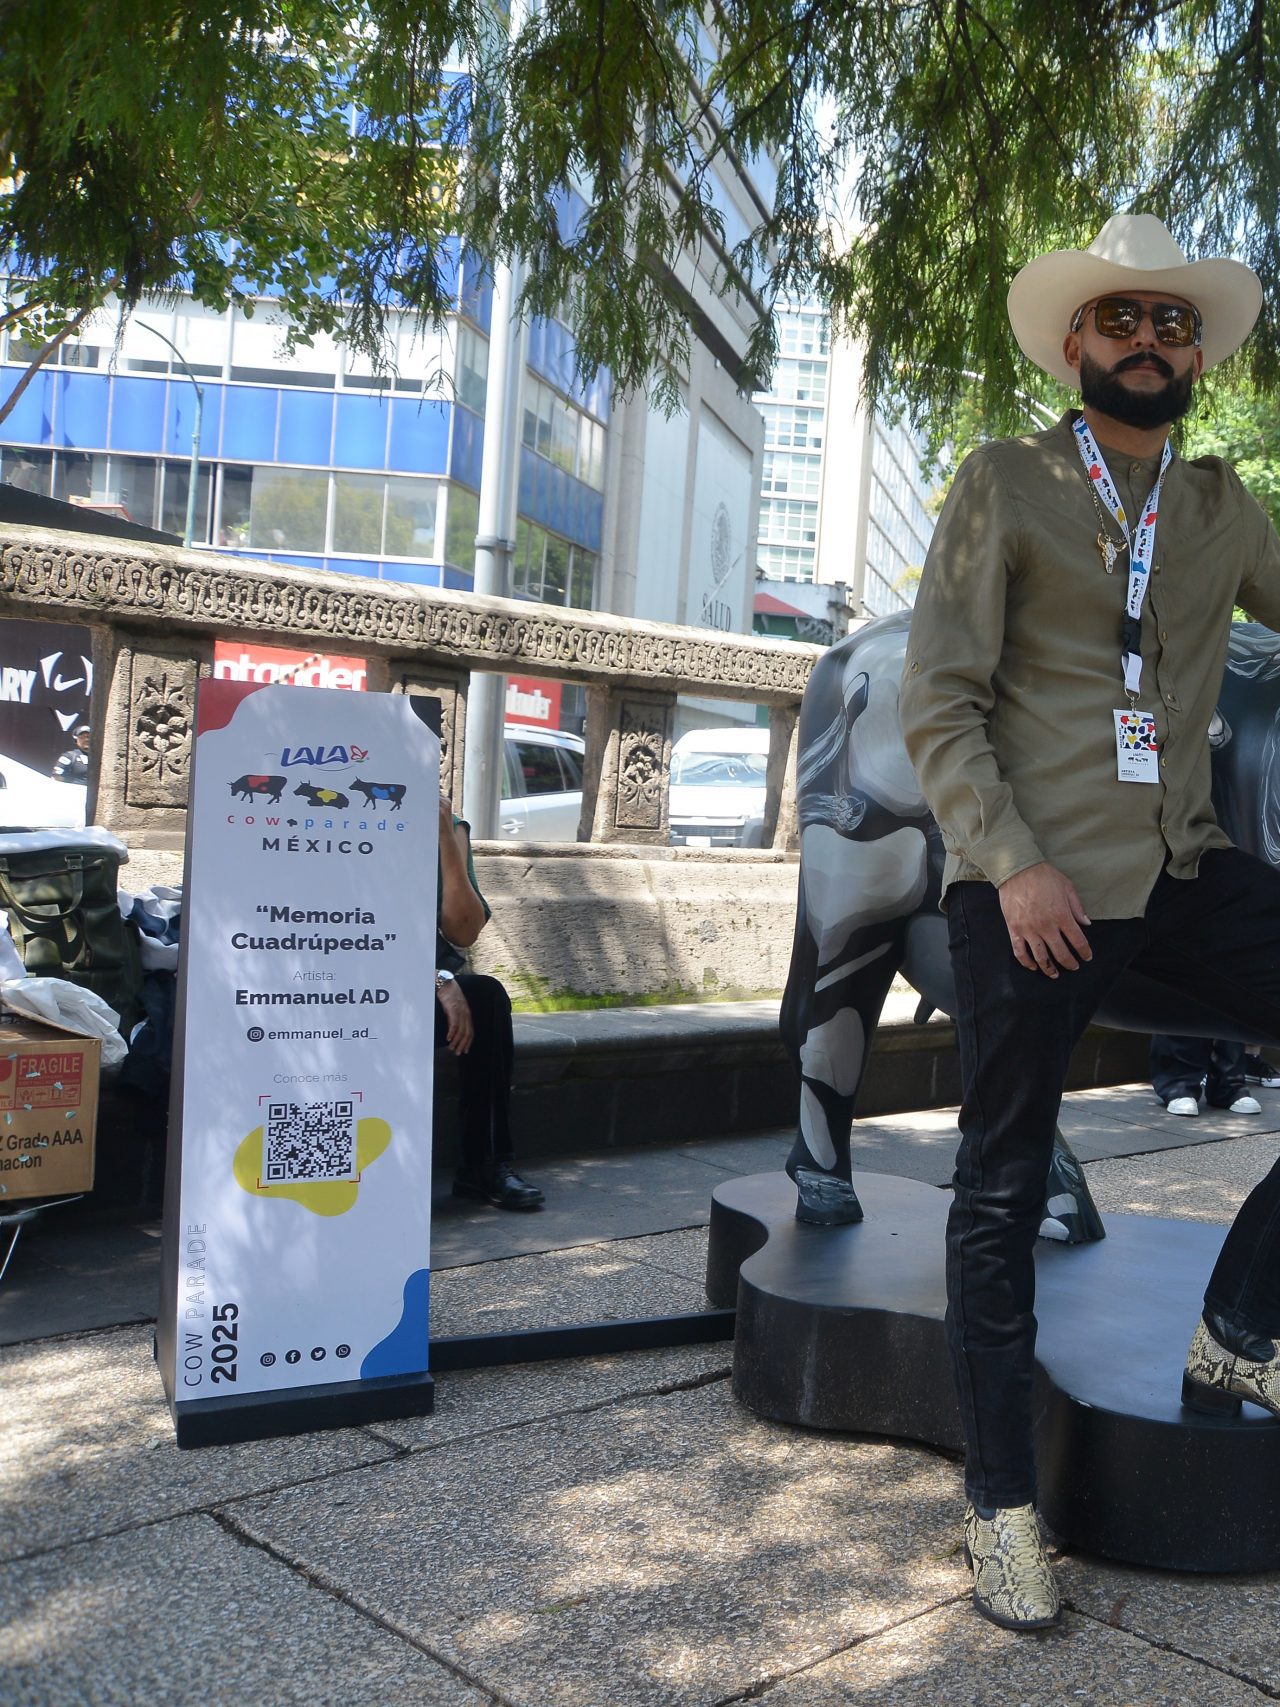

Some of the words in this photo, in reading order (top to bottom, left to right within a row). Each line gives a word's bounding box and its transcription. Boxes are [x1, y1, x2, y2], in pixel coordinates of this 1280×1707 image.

[701, 592, 731, 632] SALUD
[280, 745, 349, 767] LALA
[227, 815, 280, 826] cow
[305, 818, 405, 831] parade
[262, 835, 374, 855] MÉXICO
[293, 970, 336, 981] Artista:
[235, 989, 356, 1005] Emmanuel
[359, 989, 390, 1004] AD
[19, 1056, 80, 1076] FRAGILE
[273, 1073, 320, 1084] Conoce
[7, 1132, 49, 1150] Grado
[52, 1129, 84, 1146] AAA
[185, 1224, 208, 1319] PARADE
[211, 1303, 239, 1383] 2025
[184, 1333, 204, 1386] COW
